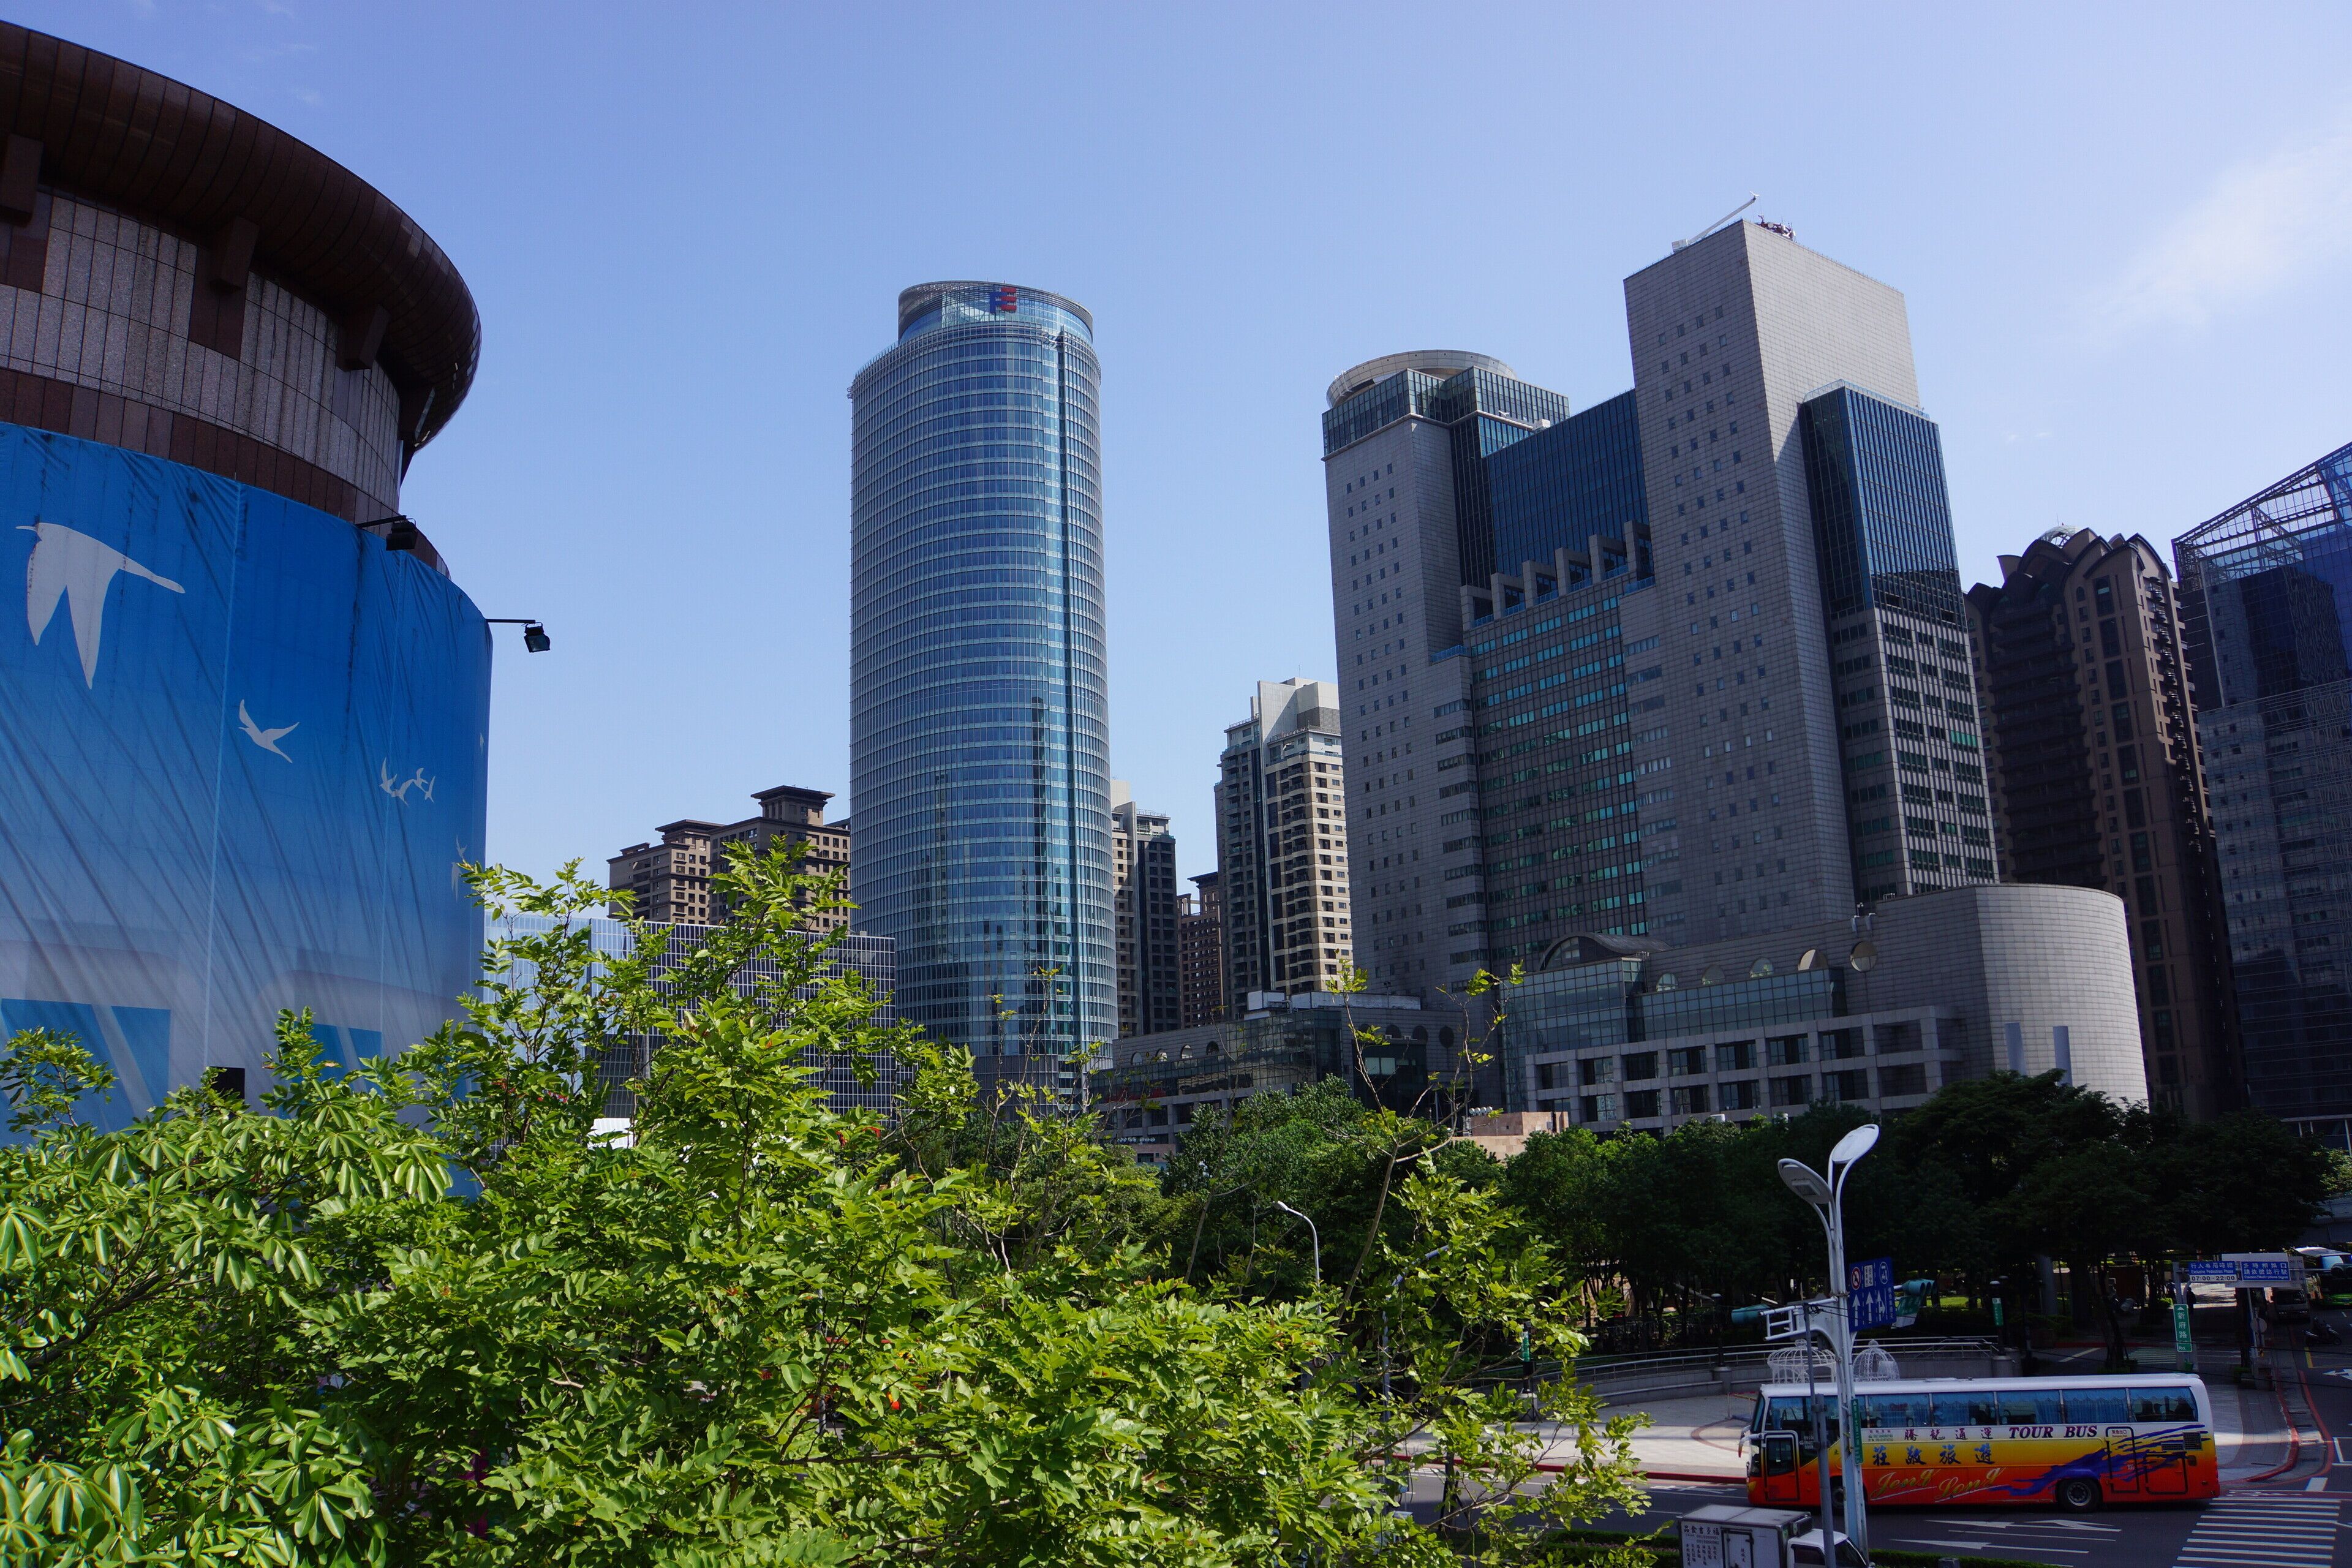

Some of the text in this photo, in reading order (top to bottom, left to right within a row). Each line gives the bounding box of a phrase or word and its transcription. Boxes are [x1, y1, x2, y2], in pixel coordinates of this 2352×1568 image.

[2177, 1312, 2187, 1338] 新府路
[2009, 1426, 2054, 1439] TOUR
[2064, 1425, 2097, 1438] BUS
